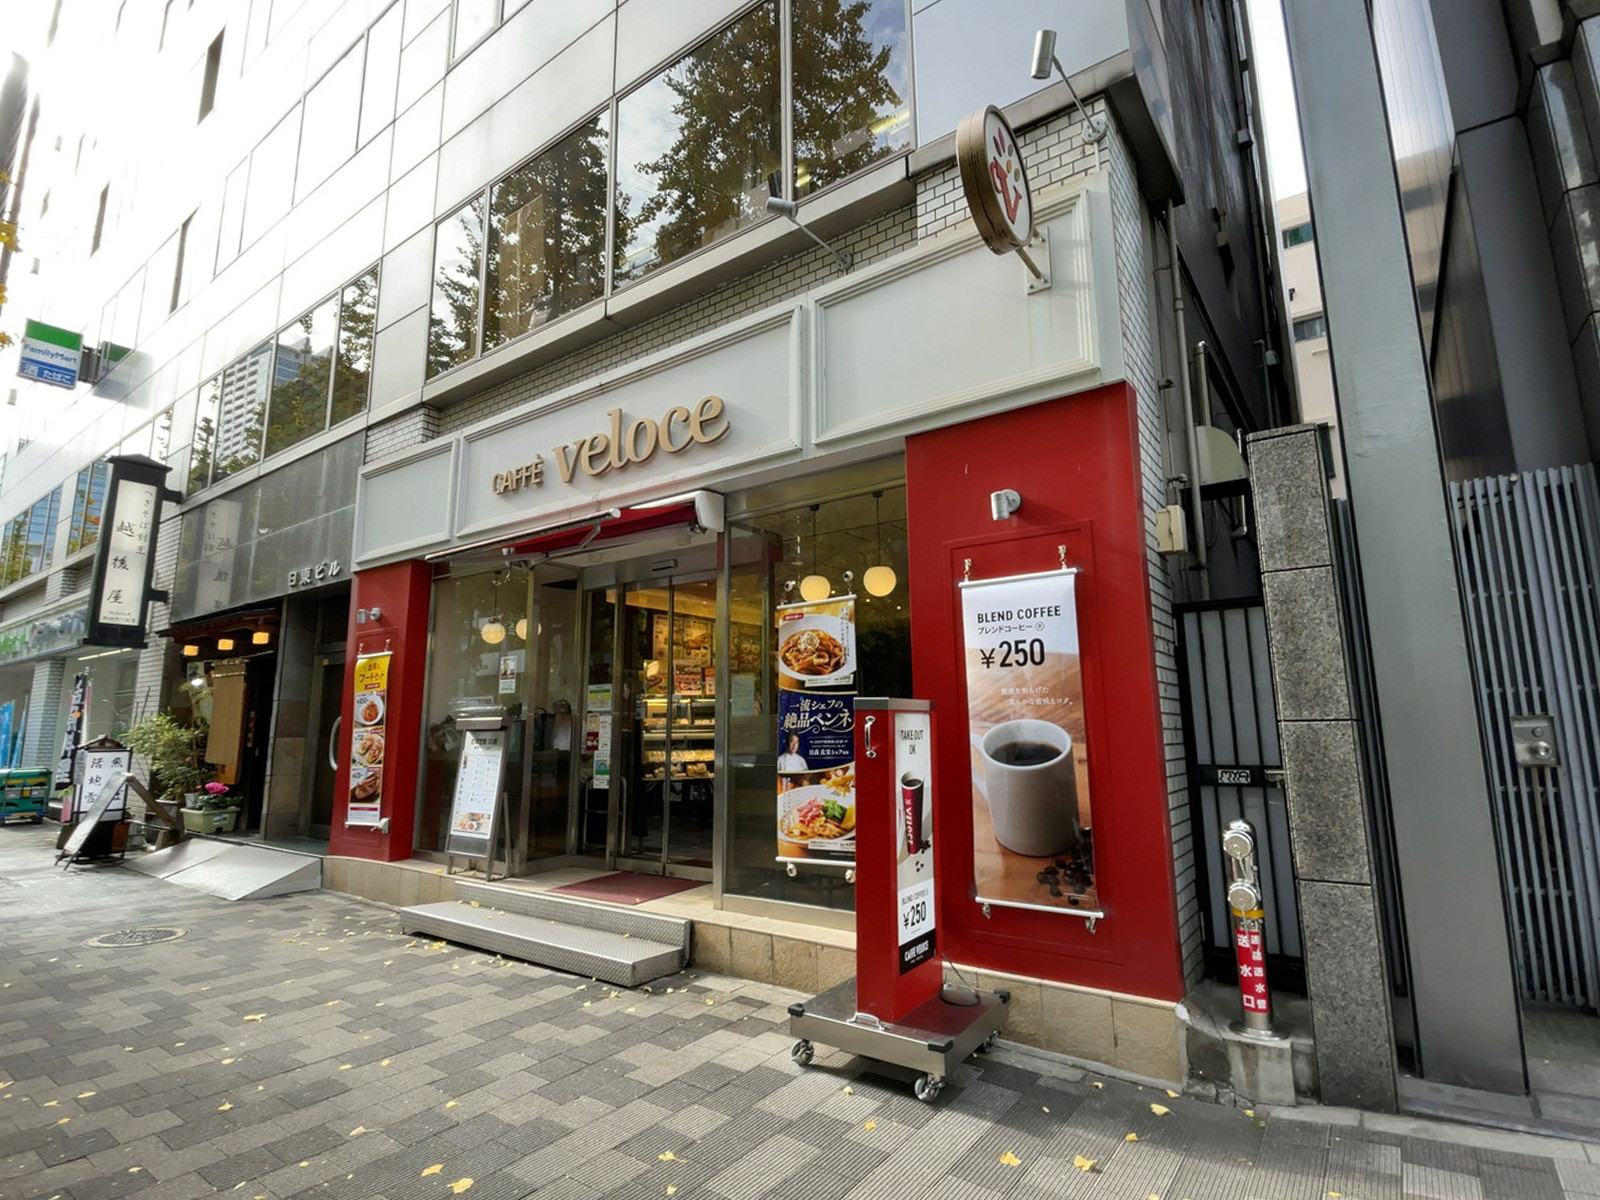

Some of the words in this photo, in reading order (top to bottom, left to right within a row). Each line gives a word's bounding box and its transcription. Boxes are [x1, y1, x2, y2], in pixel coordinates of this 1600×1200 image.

[23, 343, 77, 364] FamilyMart
[42, 369, 72, 383] たばこ
[492, 454, 543, 495] CAFFÈ
[551, 395, 731, 483] veloce
[288, 560, 341, 586] 日東ビル
[977, 610, 1013, 624] BLEND
[1017, 605, 1061, 620] COFFEE
[978, 623, 1033, 635] ブレンドコーヒー
[979, 638, 1046, 669] ¥250
[789, 699, 844, 712] 一流シェフの
[784, 709, 852, 729] 絶品ペンネ
[901, 730, 913, 740] TAKE
[914, 730, 924, 740] OUT
[909, 744, 917, 755] OK
[903, 901, 927, 930] ¥250
[1237, 934, 1255, 1008] 送水口
